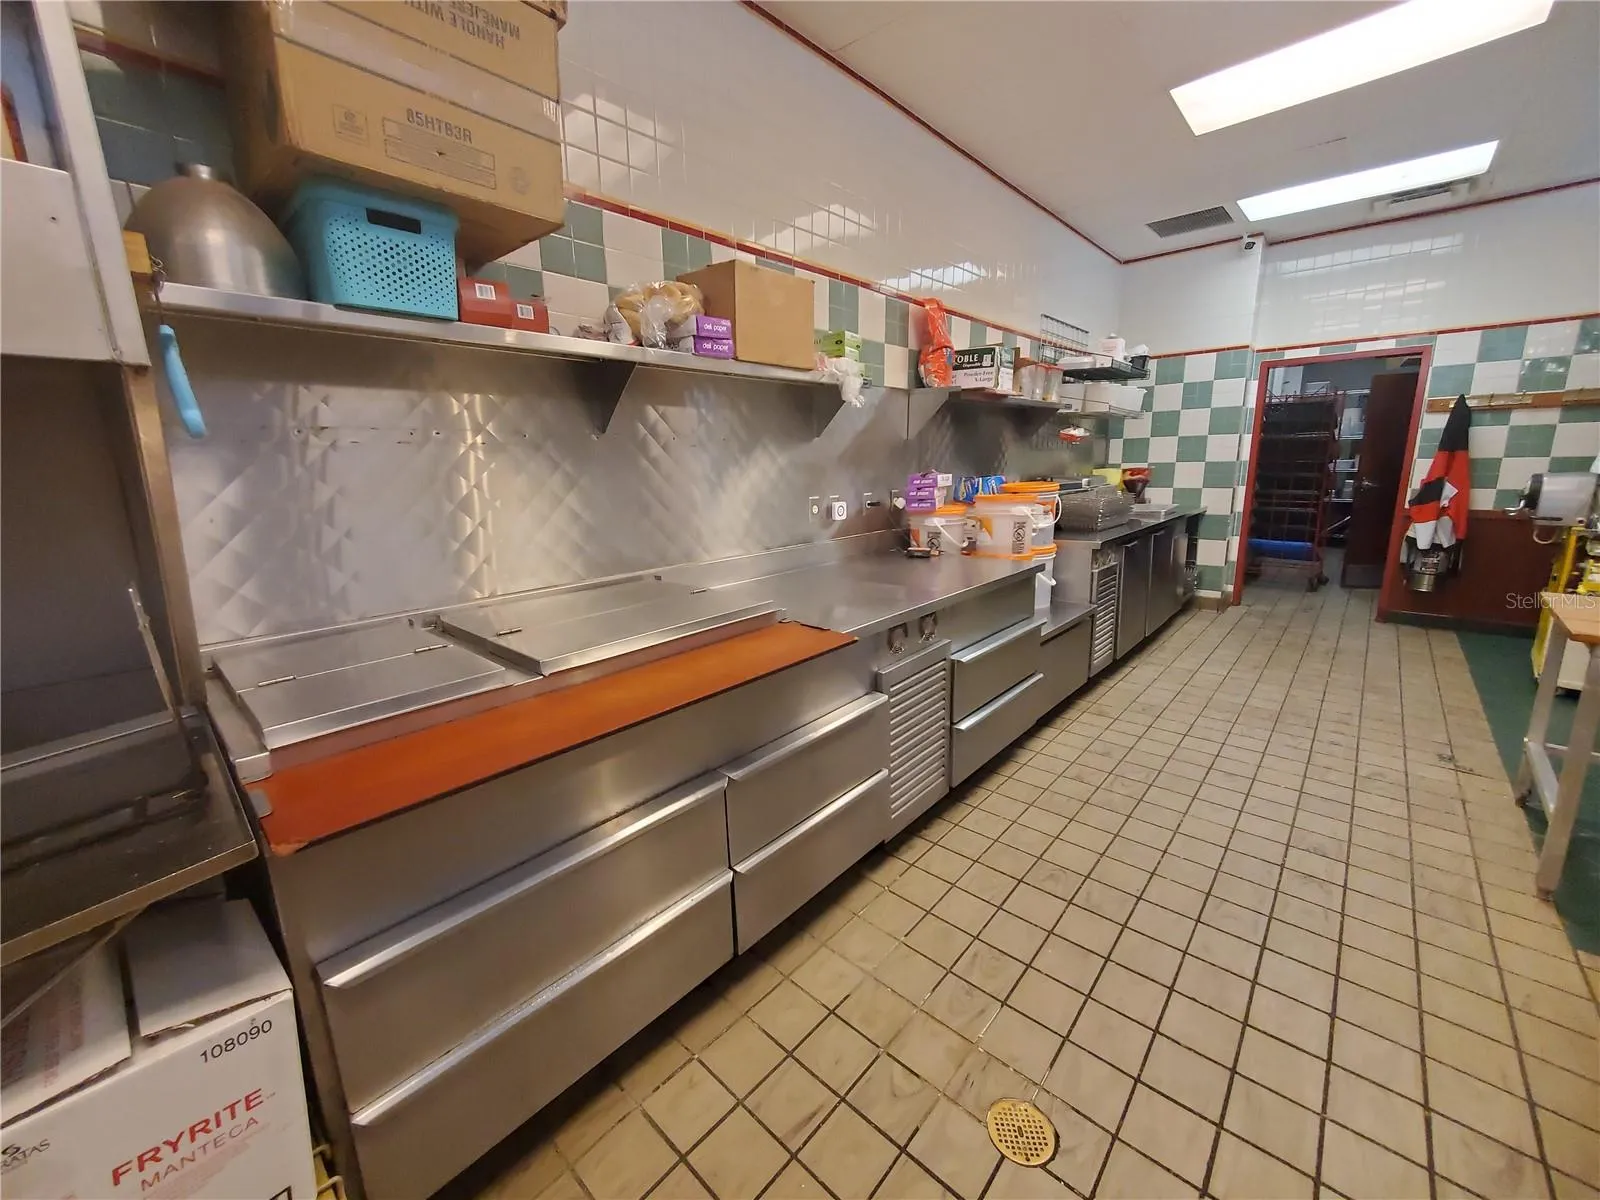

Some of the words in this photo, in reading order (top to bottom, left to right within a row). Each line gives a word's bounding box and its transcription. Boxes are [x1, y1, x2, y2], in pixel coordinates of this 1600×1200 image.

[449, 11, 504, 49] HANDLE
[702, 342, 711, 350] deli
[200, 1020, 272, 1063] 108090
[112, 1088, 264, 1186] FRYRITE
[141, 1116, 259, 1191] MANTECA
